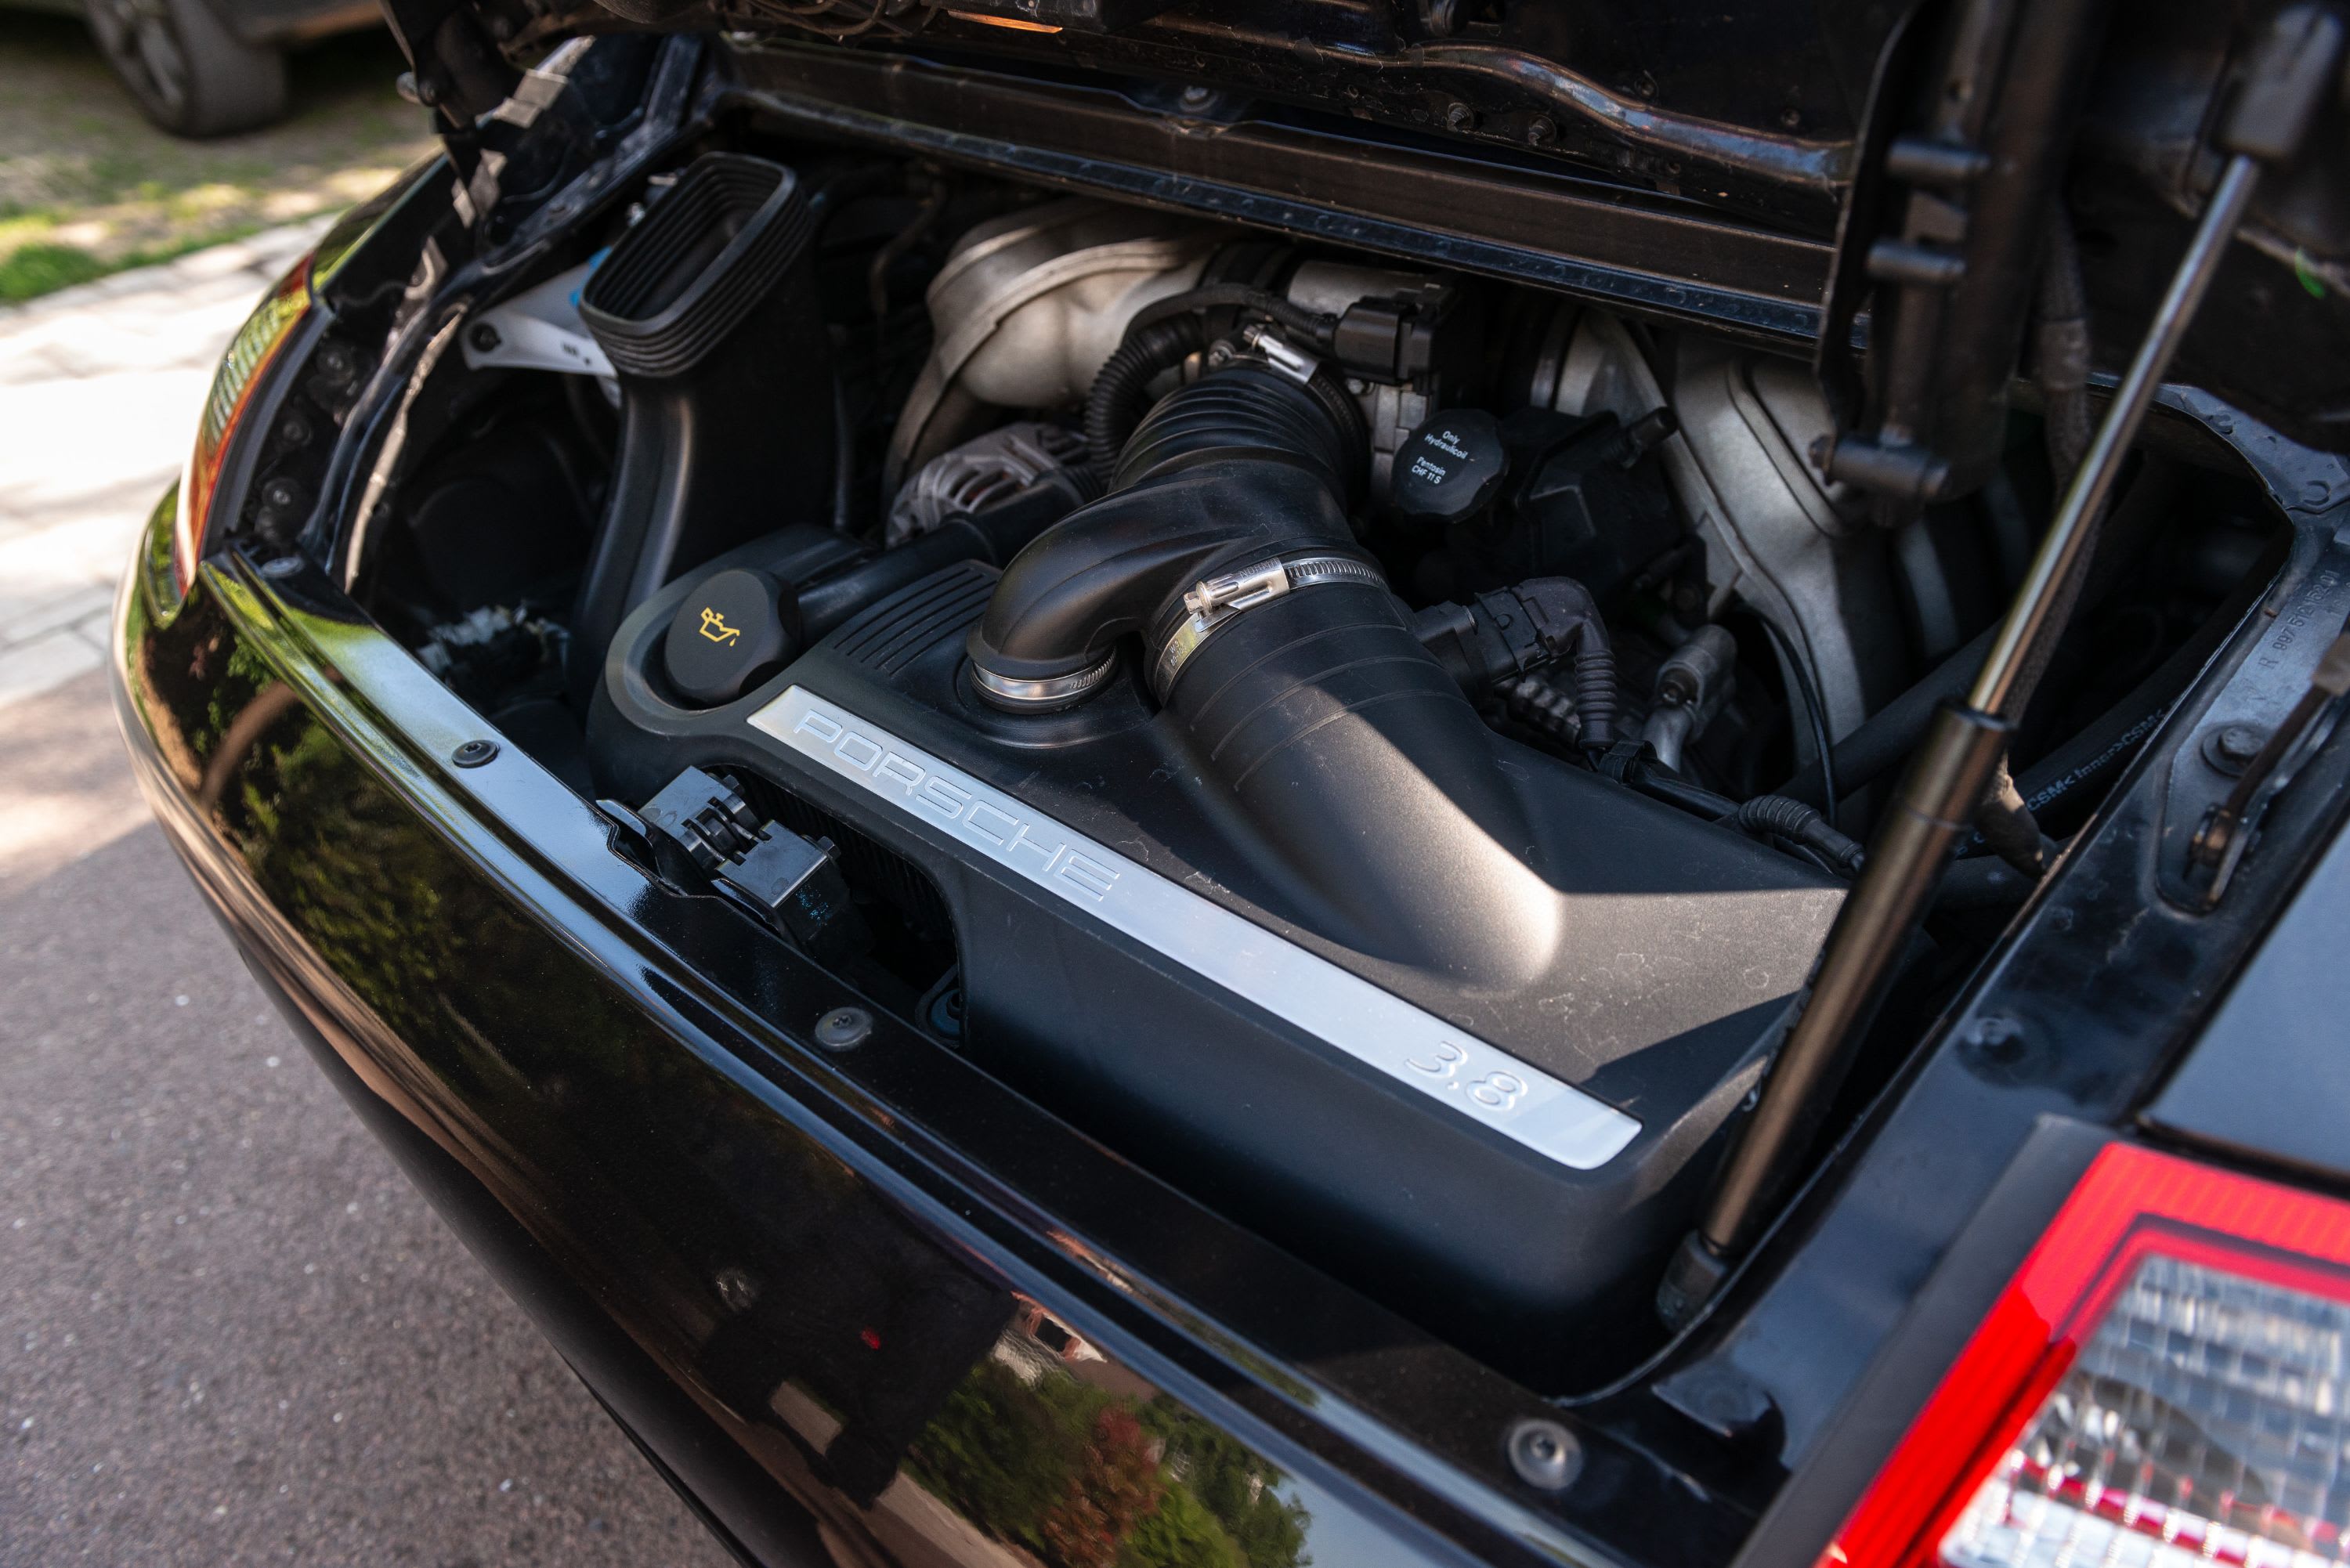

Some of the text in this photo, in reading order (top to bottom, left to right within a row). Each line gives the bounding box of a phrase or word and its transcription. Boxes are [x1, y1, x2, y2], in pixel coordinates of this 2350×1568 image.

[1442, 431, 1460, 444] Only
[1412, 465, 1428, 477] CHF
[1427, 472, 1434, 481] 11
[1416, 457, 1446, 476] Pentosin
[2272, 627, 2295, 650] 997
[794, 709, 1120, 902] PORSCHE
[1404, 1040, 1528, 1113] 3.8
